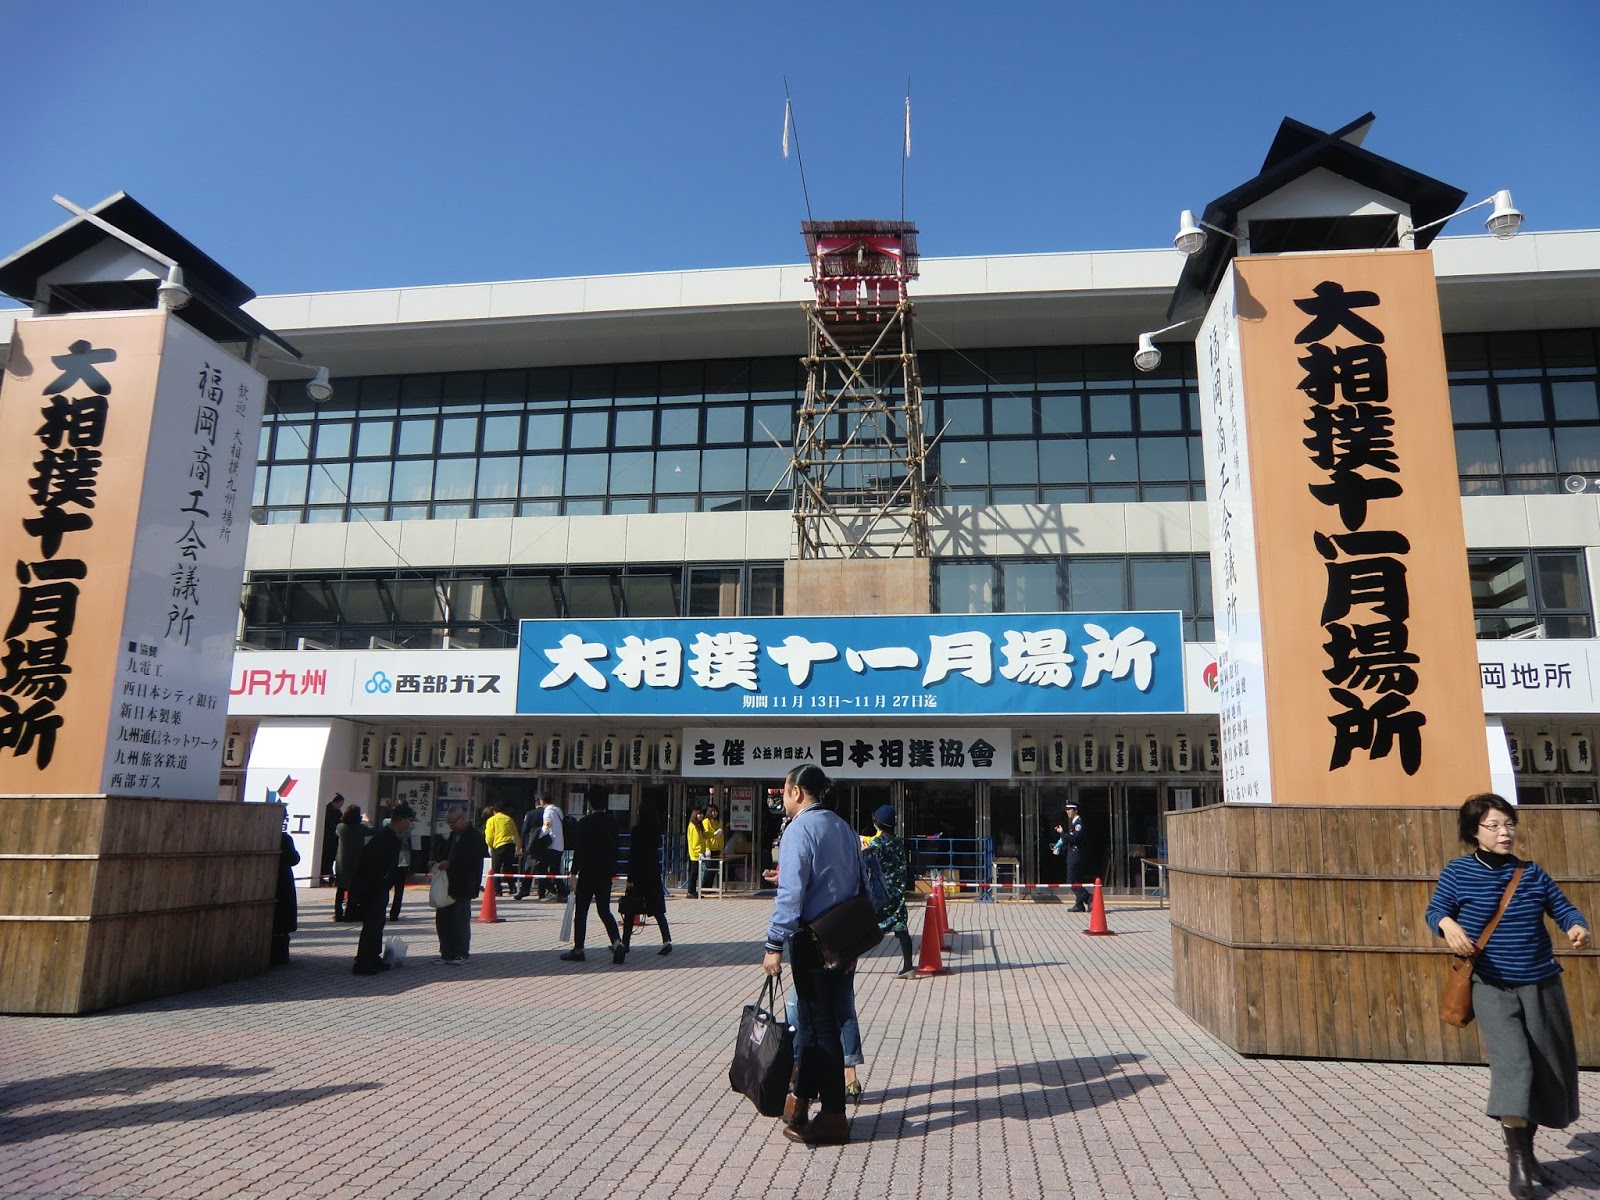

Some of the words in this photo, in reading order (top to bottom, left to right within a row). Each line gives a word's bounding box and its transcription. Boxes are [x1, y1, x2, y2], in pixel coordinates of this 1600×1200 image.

[219, 429, 242, 543] 大相撲九州場所
[1209, 324, 1237, 637] 福岡商工会議所
[163, 361, 223, 647] 福岡商工会議所
[1293, 280, 1427, 776] 大相撲十一月場所
[0, 340, 117, 771] 大相撲十一月場所
[139, 643, 157, 658] 協賛
[539, 623, 1157, 692] 大相撲十一月場所
[126, 657, 163, 678] 九電工
[229, 669, 327, 695] JR九州
[395, 674, 501, 694] 西部ガス
[123, 681, 218, 710] 西日本シティ銀行
[743, 694, 768, 709] 期間
[120, 702, 182, 726] 新日本製薬
[116, 725, 219, 751] 九州通信ネットワーク
[113, 749, 188, 770] 九州旅客鉄道
[693, 739, 745, 767] 主催
[752, 746, 814, 761] 公益財団法人
[820, 738, 996, 768] 日本相撲協會
[1021, 747, 1036, 763] 西
[110, 773, 161, 789] 西部ガス
[1226, 765, 1245, 781] ピエトロ
